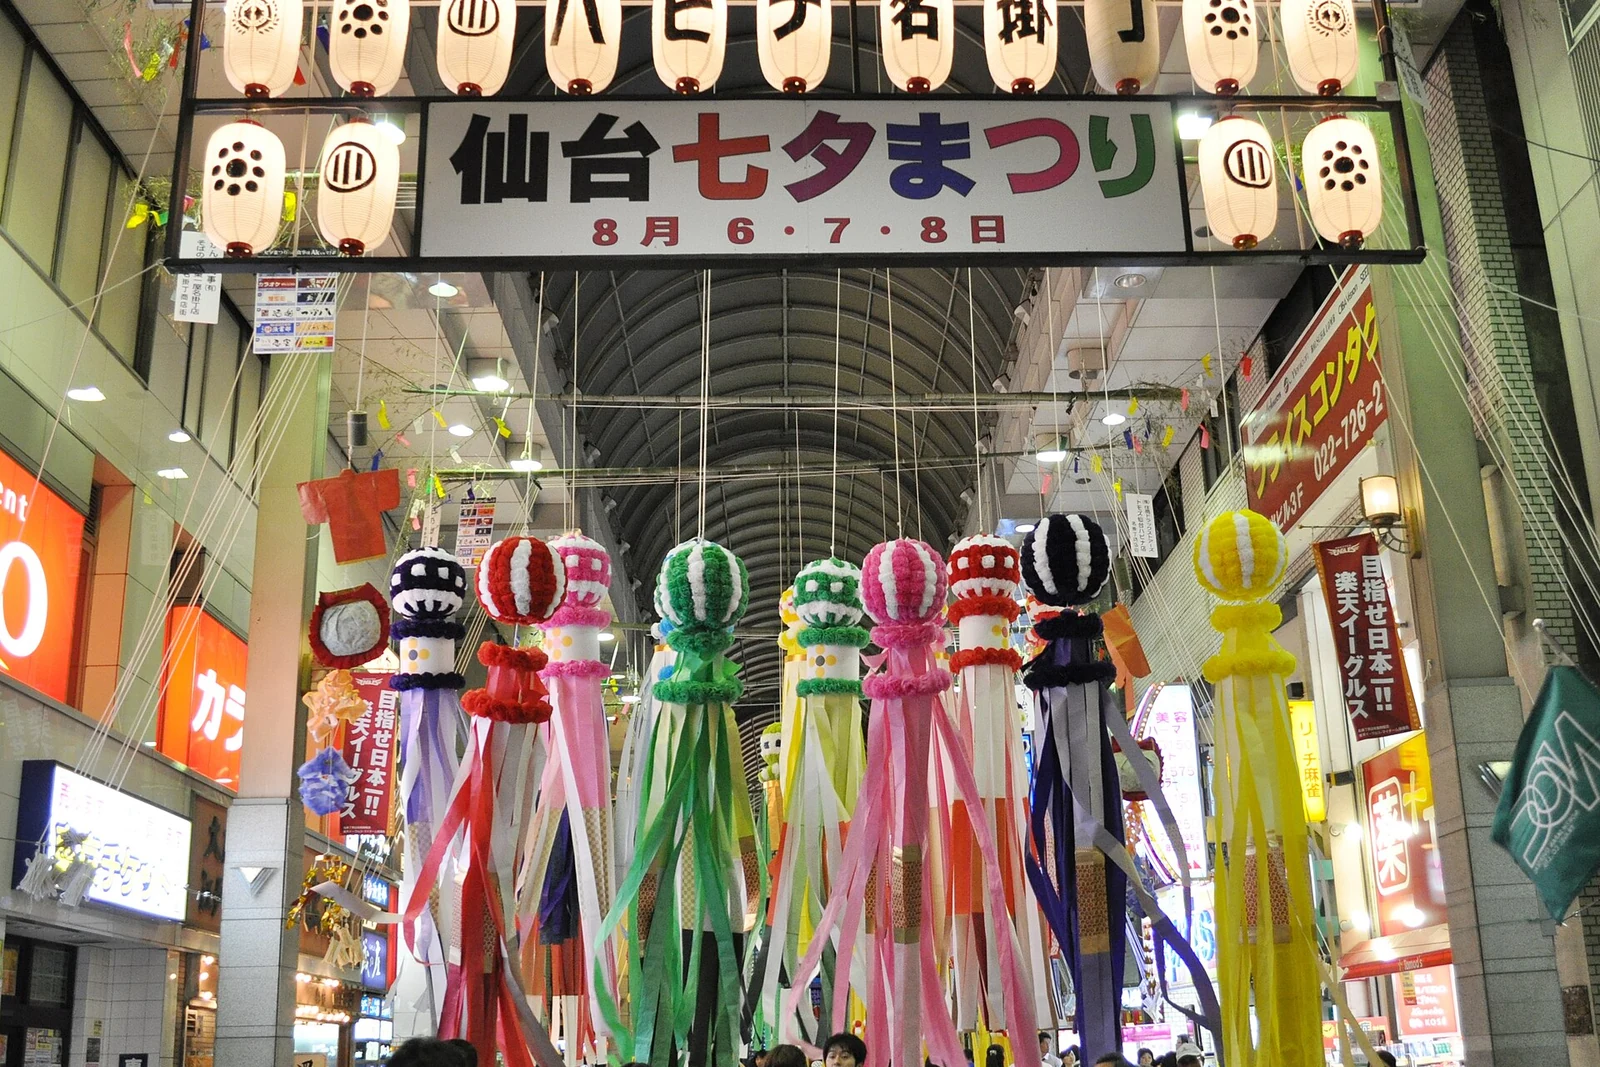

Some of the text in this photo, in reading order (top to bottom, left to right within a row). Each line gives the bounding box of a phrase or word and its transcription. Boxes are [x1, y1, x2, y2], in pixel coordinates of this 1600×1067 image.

[450, 110, 1155, 204] 仙台七夕まつり
[592, 215, 679, 247] 8月
[1313, 379, 1384, 482] 022-726-2
[1335, 570, 1369, 719] 楽天イーグルス
[1300, 722, 1321, 798] リーチ麻雀
